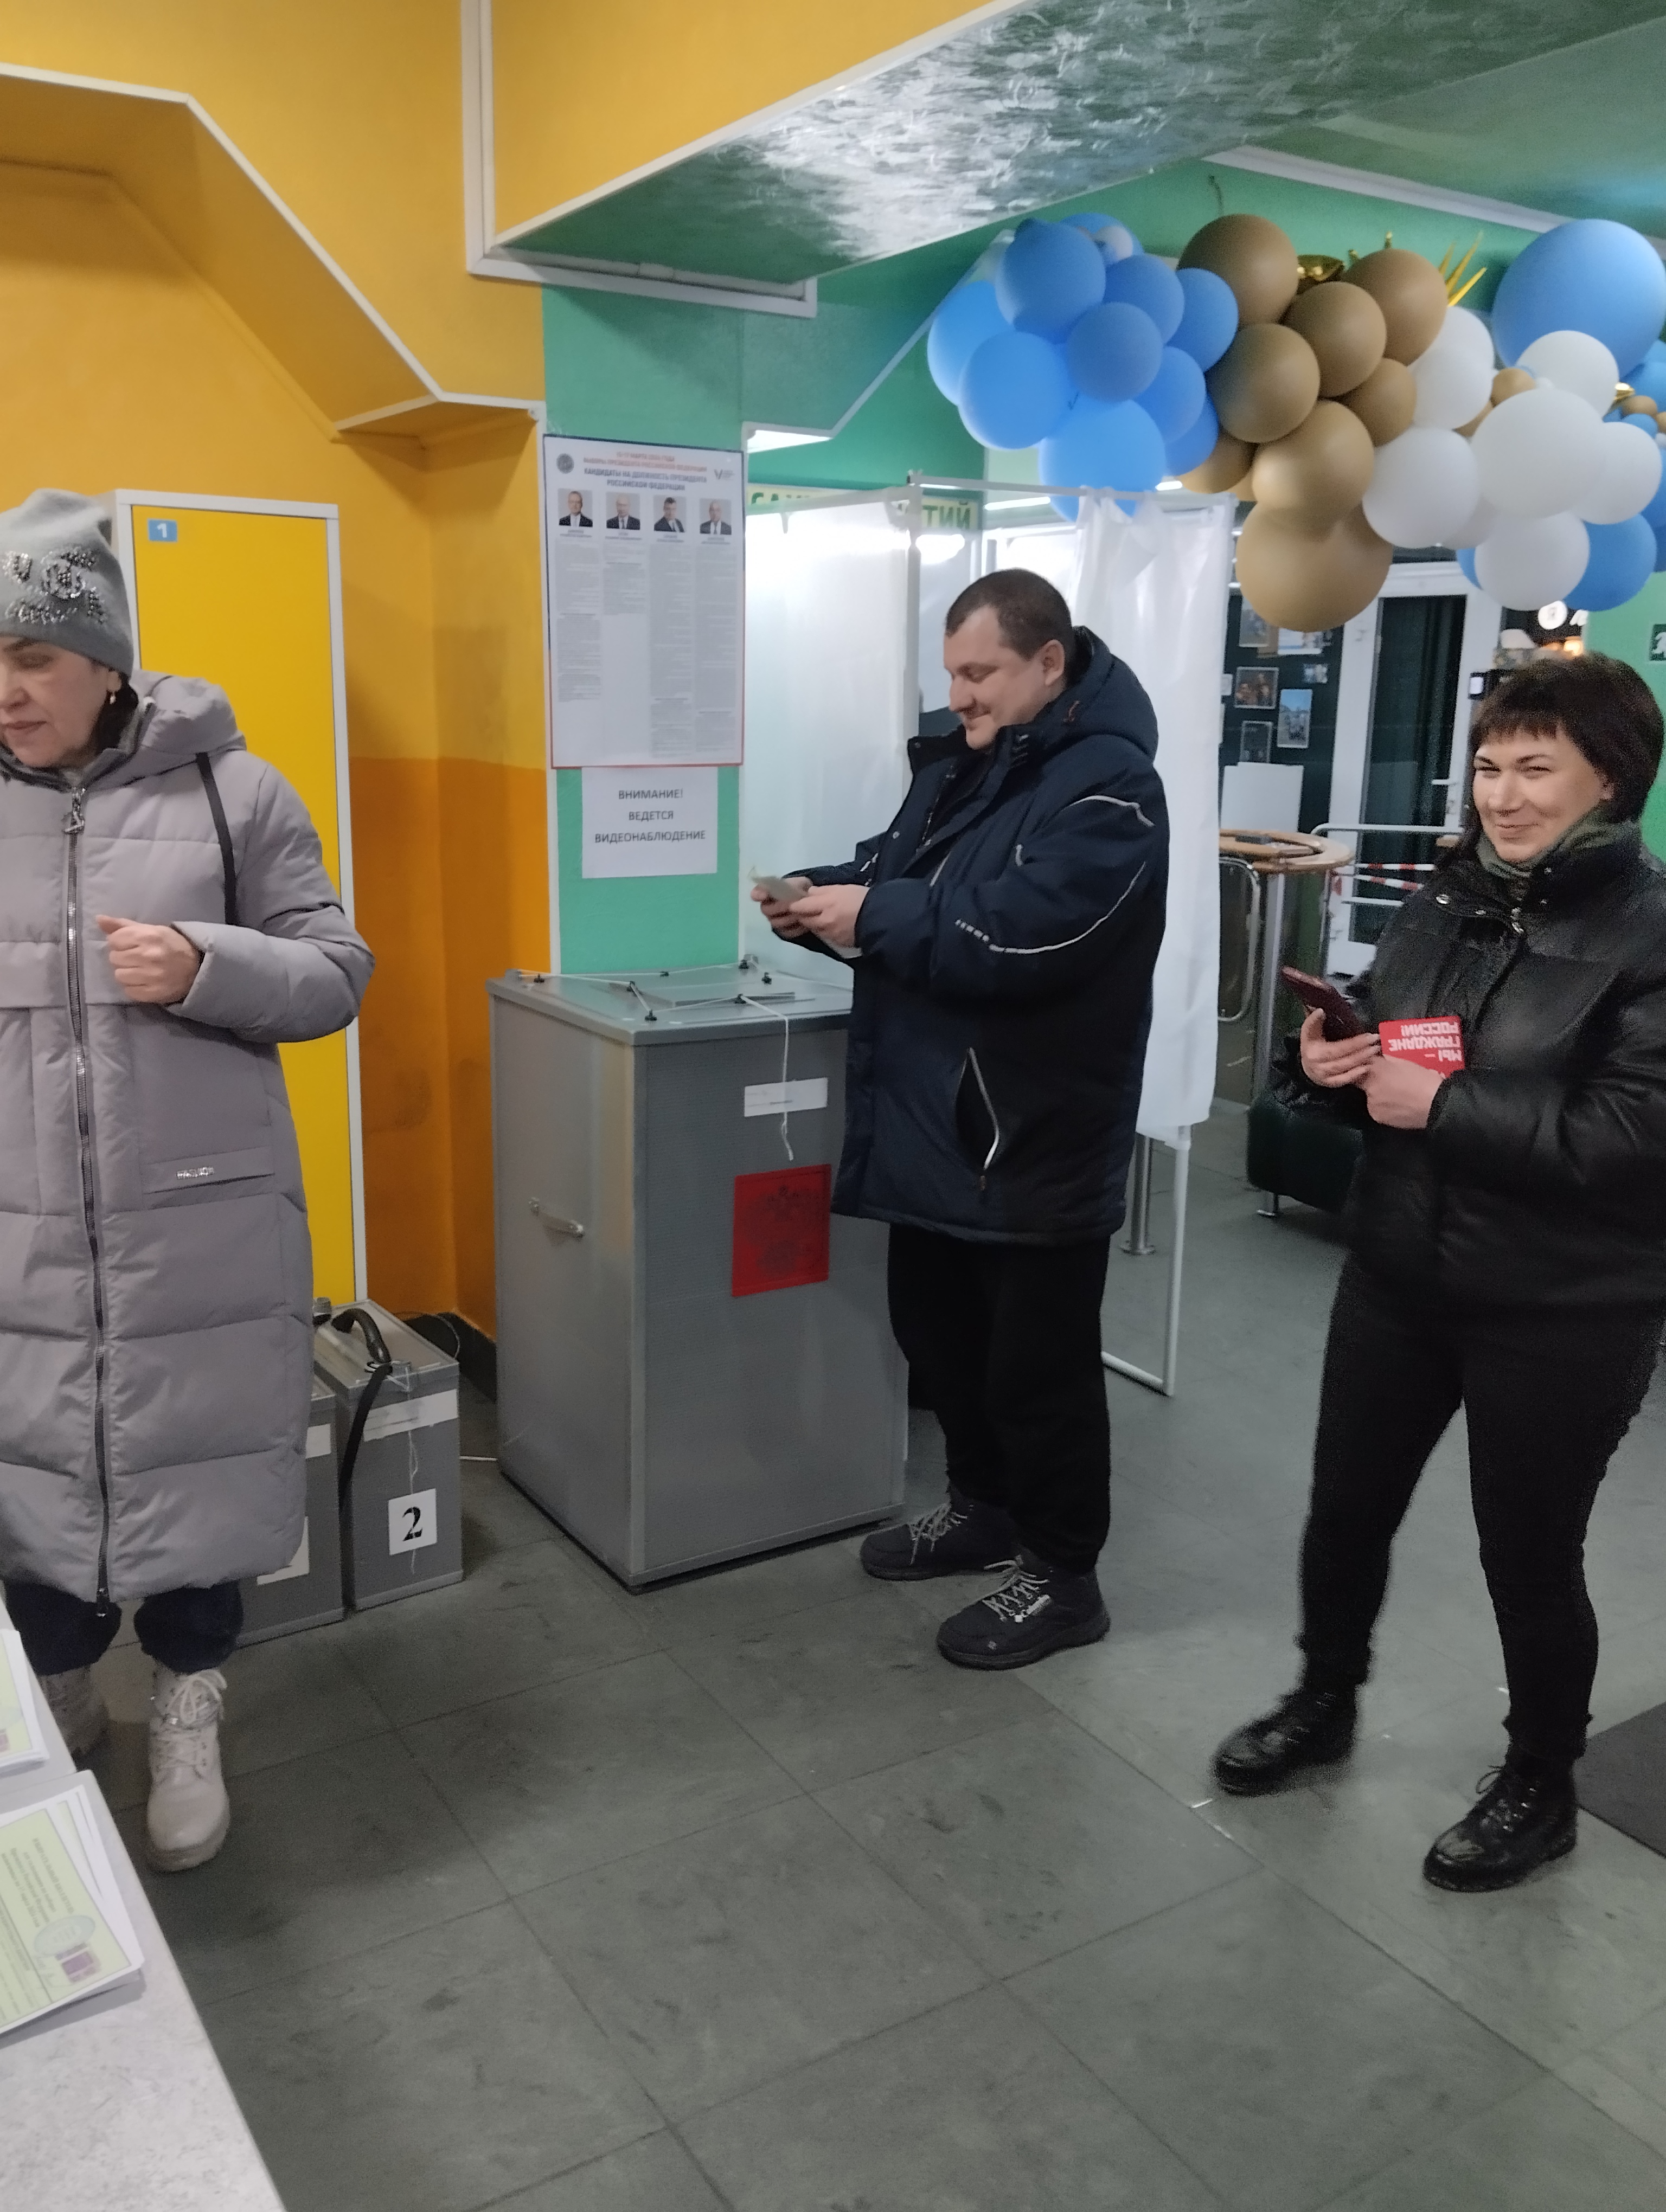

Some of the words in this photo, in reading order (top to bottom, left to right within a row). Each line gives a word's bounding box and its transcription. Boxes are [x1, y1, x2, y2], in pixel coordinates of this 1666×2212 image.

[157, 523, 167, 538] 1
[619, 788, 683, 800] ВНИМАНИЕ!
[629, 811, 674, 822] ВЕДЕТСЯ
[595, 830, 706, 844] ВИДЕОНАБЛЮДЕНИЕ
[1401, 1021, 1460, 1037] РОССИИ!
[1388, 1036, 1461, 1052] ГРАЖДАНЕ
[1438, 1049, 1463, 1062] МЫ
[402, 1506, 423, 1541] 2
